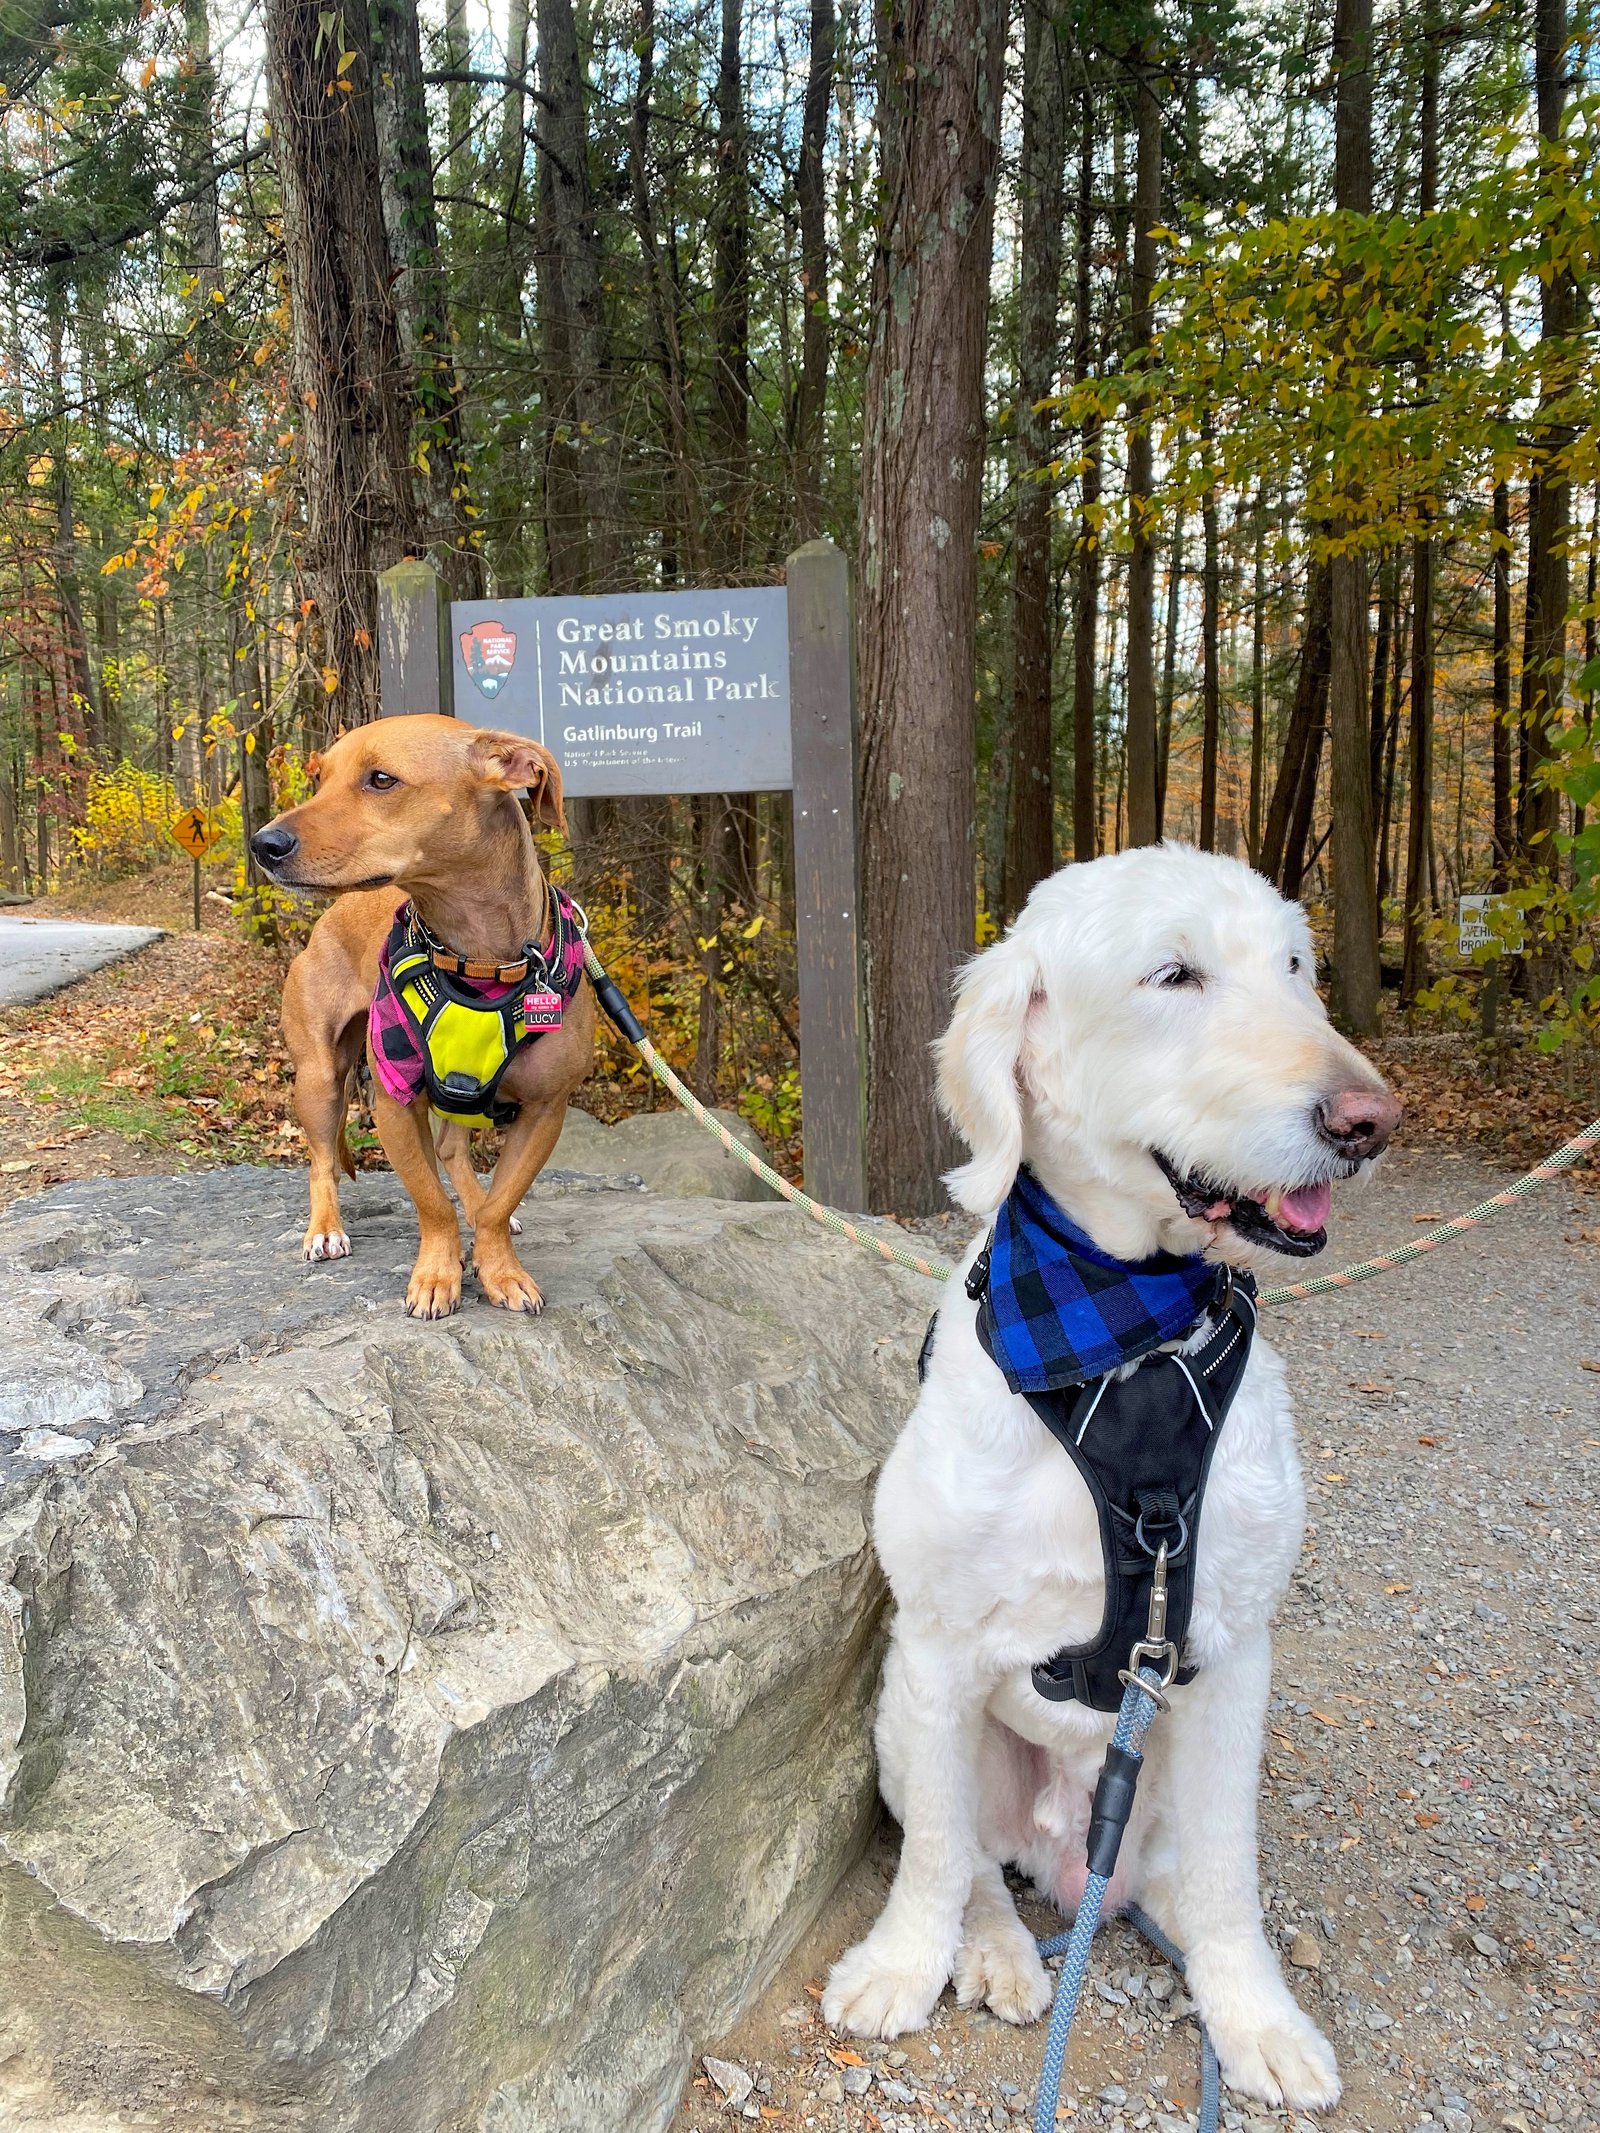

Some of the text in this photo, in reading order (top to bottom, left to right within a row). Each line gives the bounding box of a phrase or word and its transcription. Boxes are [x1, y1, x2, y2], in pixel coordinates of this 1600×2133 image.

[556, 610, 759, 643] Great Smoky
[558, 645, 727, 675] Mountains
[558, 673, 781, 706] National Park
[563, 721, 702, 743] Gatlinburg Trail
[564, 749, 598, 758] Nationl
[526, 997, 558, 1005] HELLO
[530, 1014, 555, 1023] LUCY
